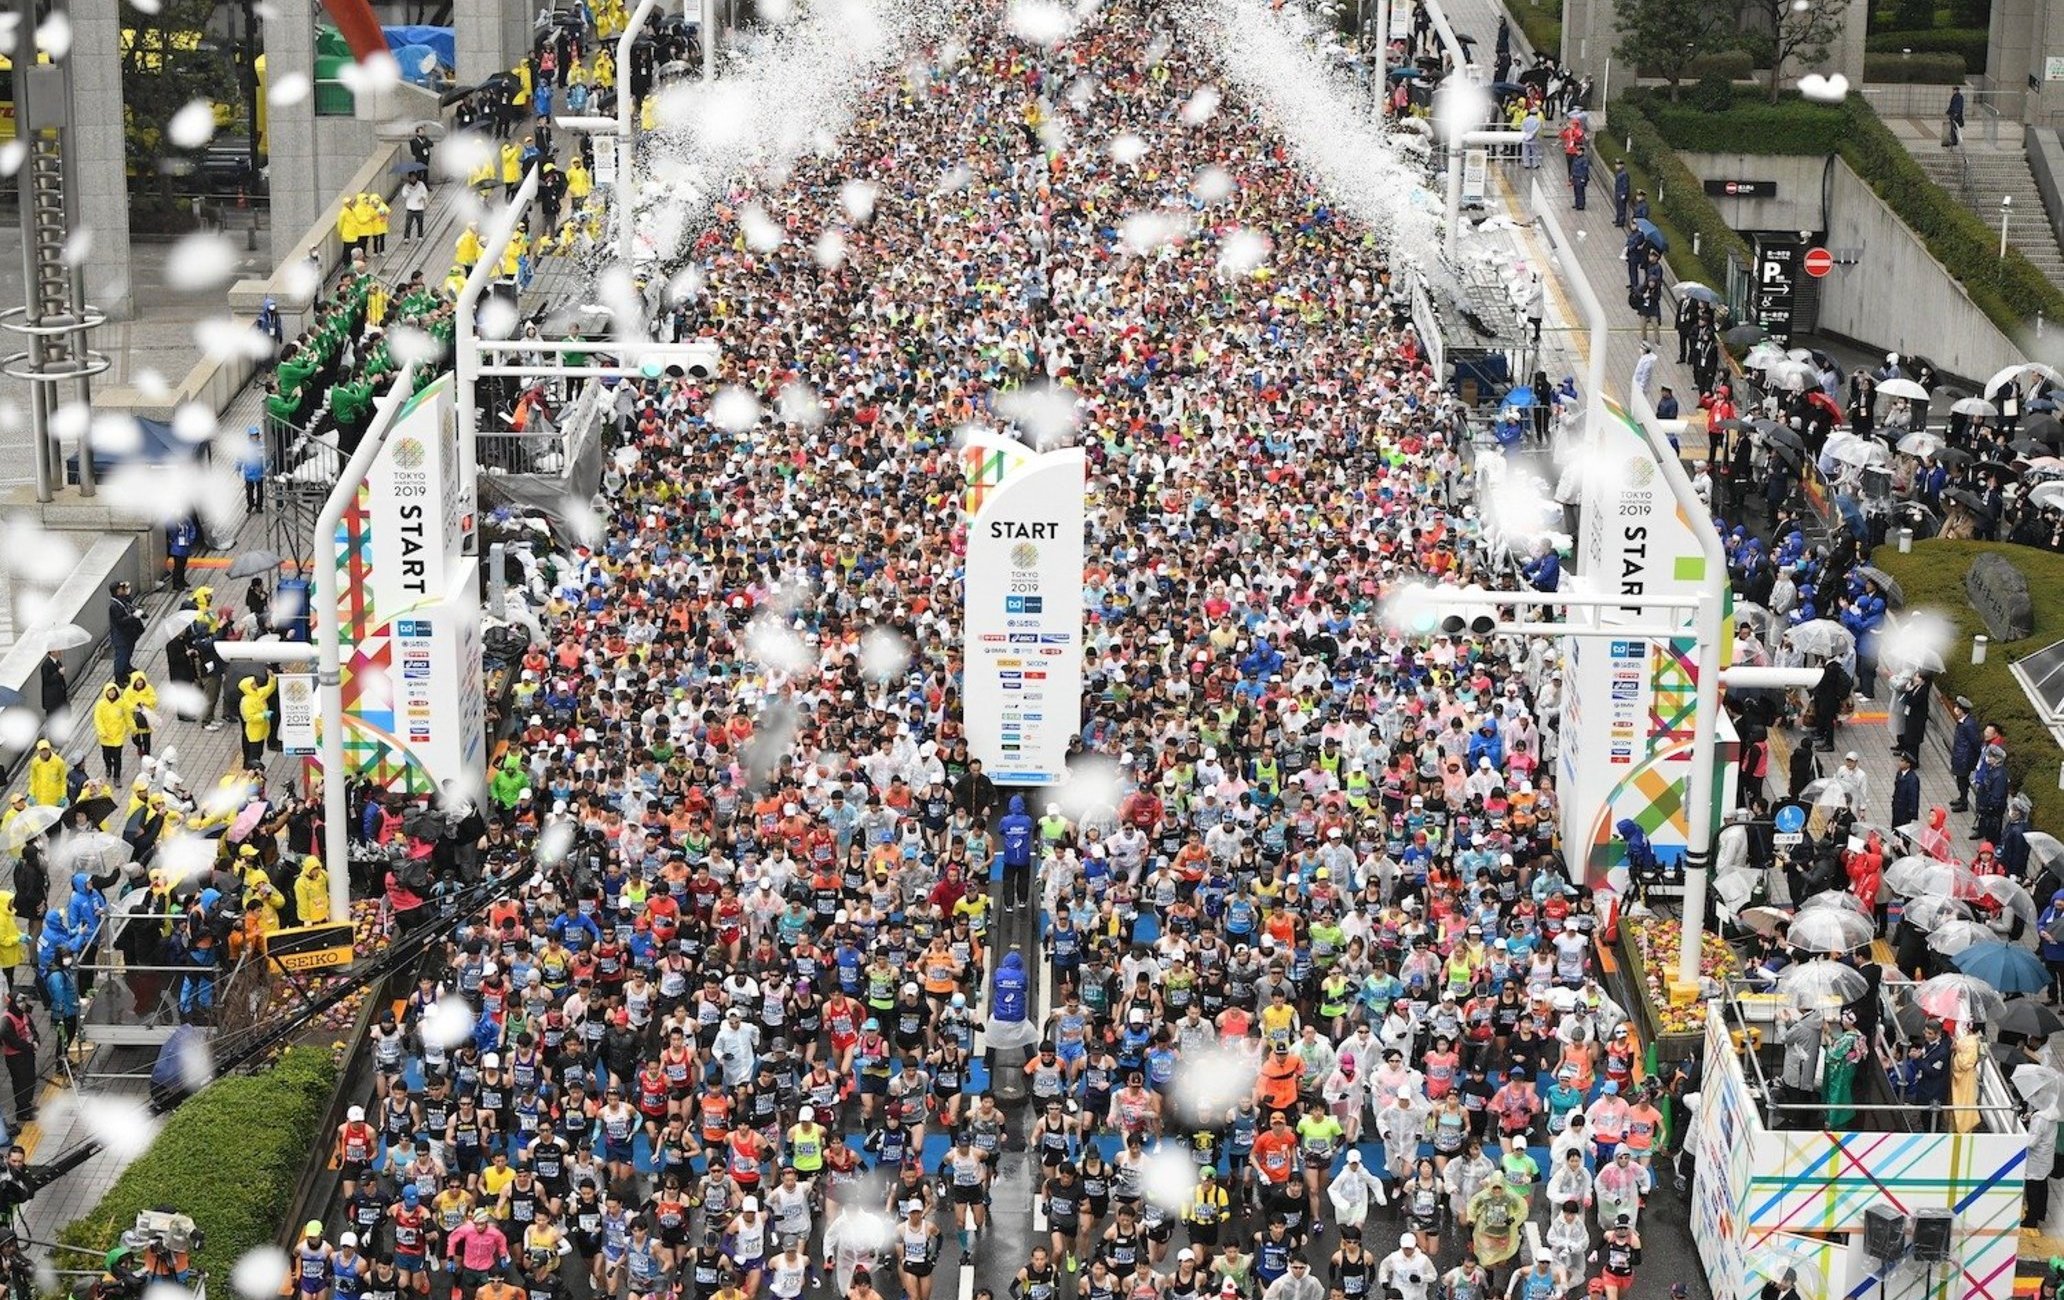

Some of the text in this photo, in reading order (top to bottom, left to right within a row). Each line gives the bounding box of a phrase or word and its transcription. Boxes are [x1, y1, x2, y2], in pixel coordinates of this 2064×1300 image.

[1763, 262, 1781, 283] P
[394, 472, 426, 480] TOKYO
[394, 486, 427, 497] 2019
[1621, 491, 1653, 499] TOKYO
[1619, 505, 1651, 516] 2019
[991, 521, 1059, 540] START
[400, 505, 425, 594] START
[1011, 571, 1039, 579] TOKYO
[1620, 526, 1647, 616] START
[1011, 583, 1039, 593] 2019
[286, 715, 310, 723] 2019
[285, 952, 338, 969] SEIKO
